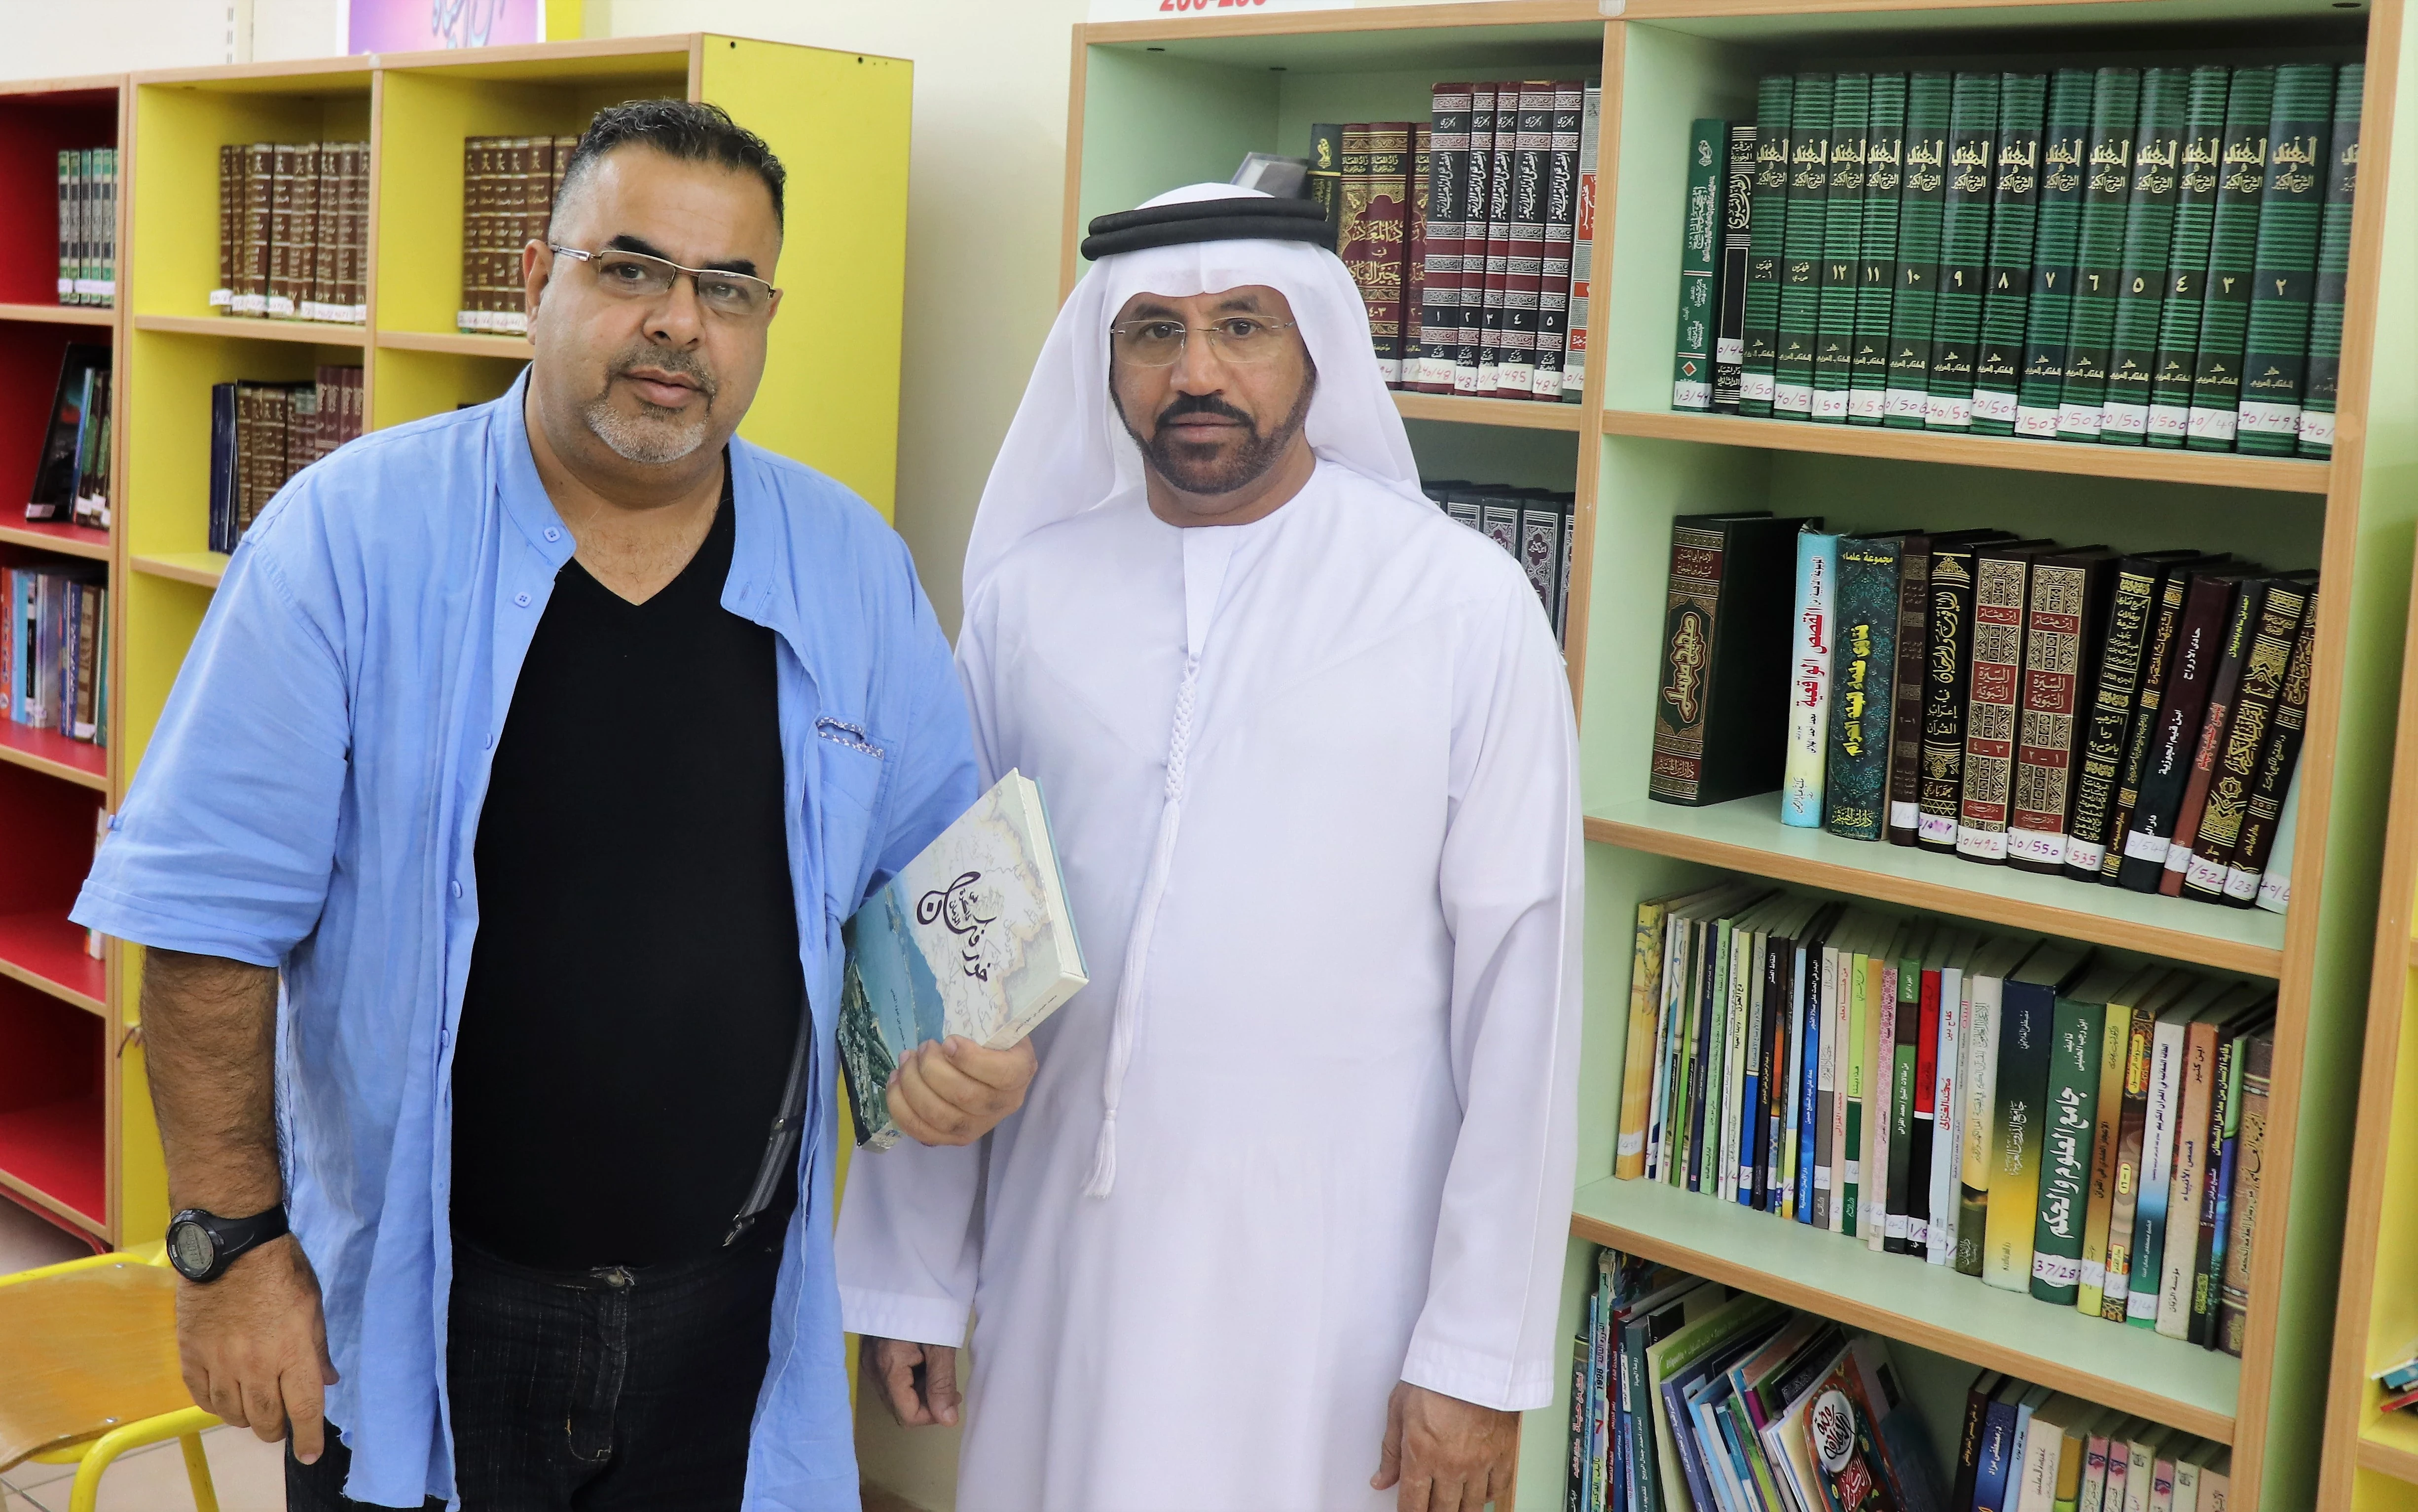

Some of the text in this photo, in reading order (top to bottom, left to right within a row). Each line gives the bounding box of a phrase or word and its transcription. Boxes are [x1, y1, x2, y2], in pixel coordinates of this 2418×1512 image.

[1867, 171, 1899, 189] الشرح الكبير
[1907, 171, 1941, 191] الشرح الكبير
[1997, 173, 2033, 193] الشرح الكبير
[2135, 174, 2173, 194] الشرح الكبير
[1832, 264, 1847, 280] ١٢
[1867, 267, 1879, 282] ١١
[1907, 268, 1920, 284] ١٠
[1954, 270, 1962, 287] ٩
[1998, 272, 2009, 288] ٨
[2045, 272, 2055, 288] ٧
[2089, 275, 2099, 291] ٦
[2133, 277, 2144, 293] ٥
[2176, 276, 2188, 292] ٤
[2223, 277, 2235, 293] ٣
[2276, 279, 2287, 295] ٢
[1436, 312, 1440, 322] ١
[1465, 312, 1470, 322] ٢
[1487, 315, 1493, 324] ٣
[1514, 314, 1521, 324] ٤
[1547, 316, 1553, 325] ٥
[1841, 550, 1893, 564] مجموعة علماء
[1796, 608, 1827, 707] القصص الواقعية
[1666, 615, 1701, 718] صحيح مسلم
[1979, 667, 2009, 683] السيرة
[2033, 674, 2065, 691] السيرة
[1935, 689, 1950, 702] في
[1977, 683, 2008, 700] النبوية
[2031, 691, 2063, 709] النبوية
[1927, 720, 1956, 735] القرآن
[1945, 1010, 1953, 1026] كفاح
[2193, 1046, 2204, 1083] ابن كثير
[2041, 1086, 2090, 1239] جامع العلوم والحكم
[2181, 1141, 2194, 1201] قصص الأنبياء
